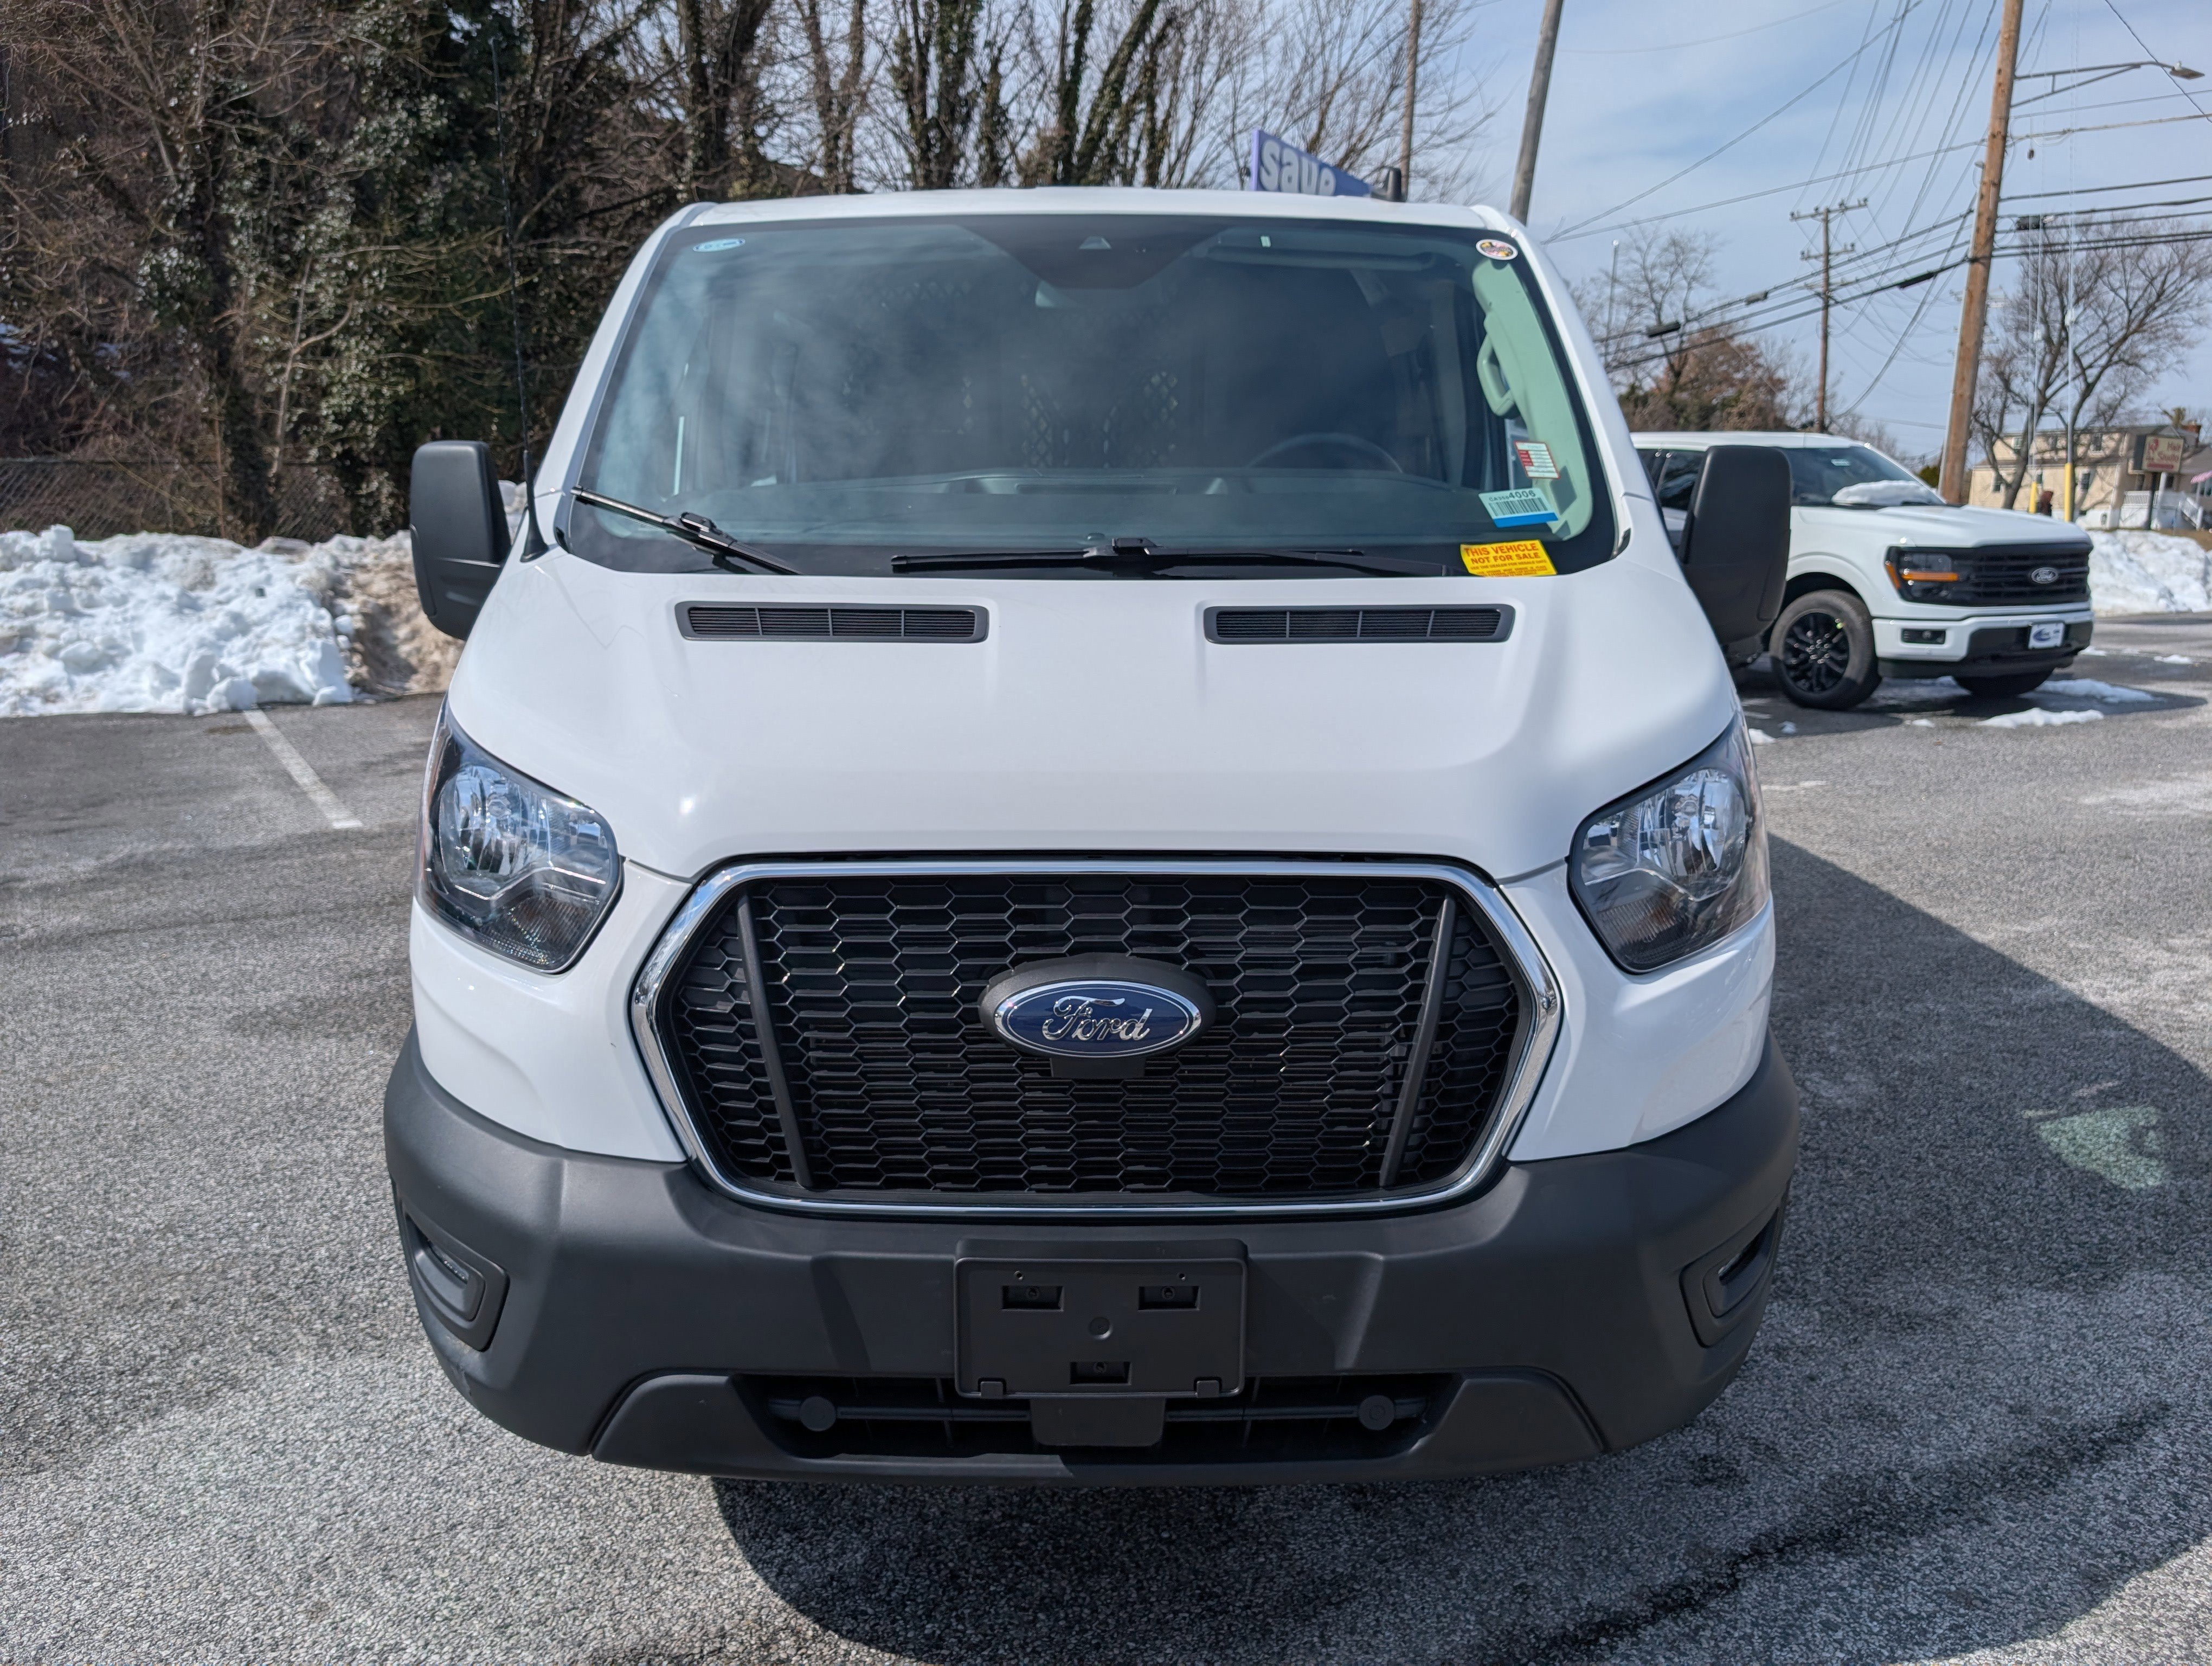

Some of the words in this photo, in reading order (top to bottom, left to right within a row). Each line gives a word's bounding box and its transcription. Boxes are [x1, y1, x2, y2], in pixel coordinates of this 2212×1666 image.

[1464, 547, 1490, 556] THIS
[1491, 543, 1539, 554] VEHICLE
[1471, 556, 1490, 565] NOT
[1515, 552, 1540, 560] SALE
[1042, 996, 1153, 1041] Ford
